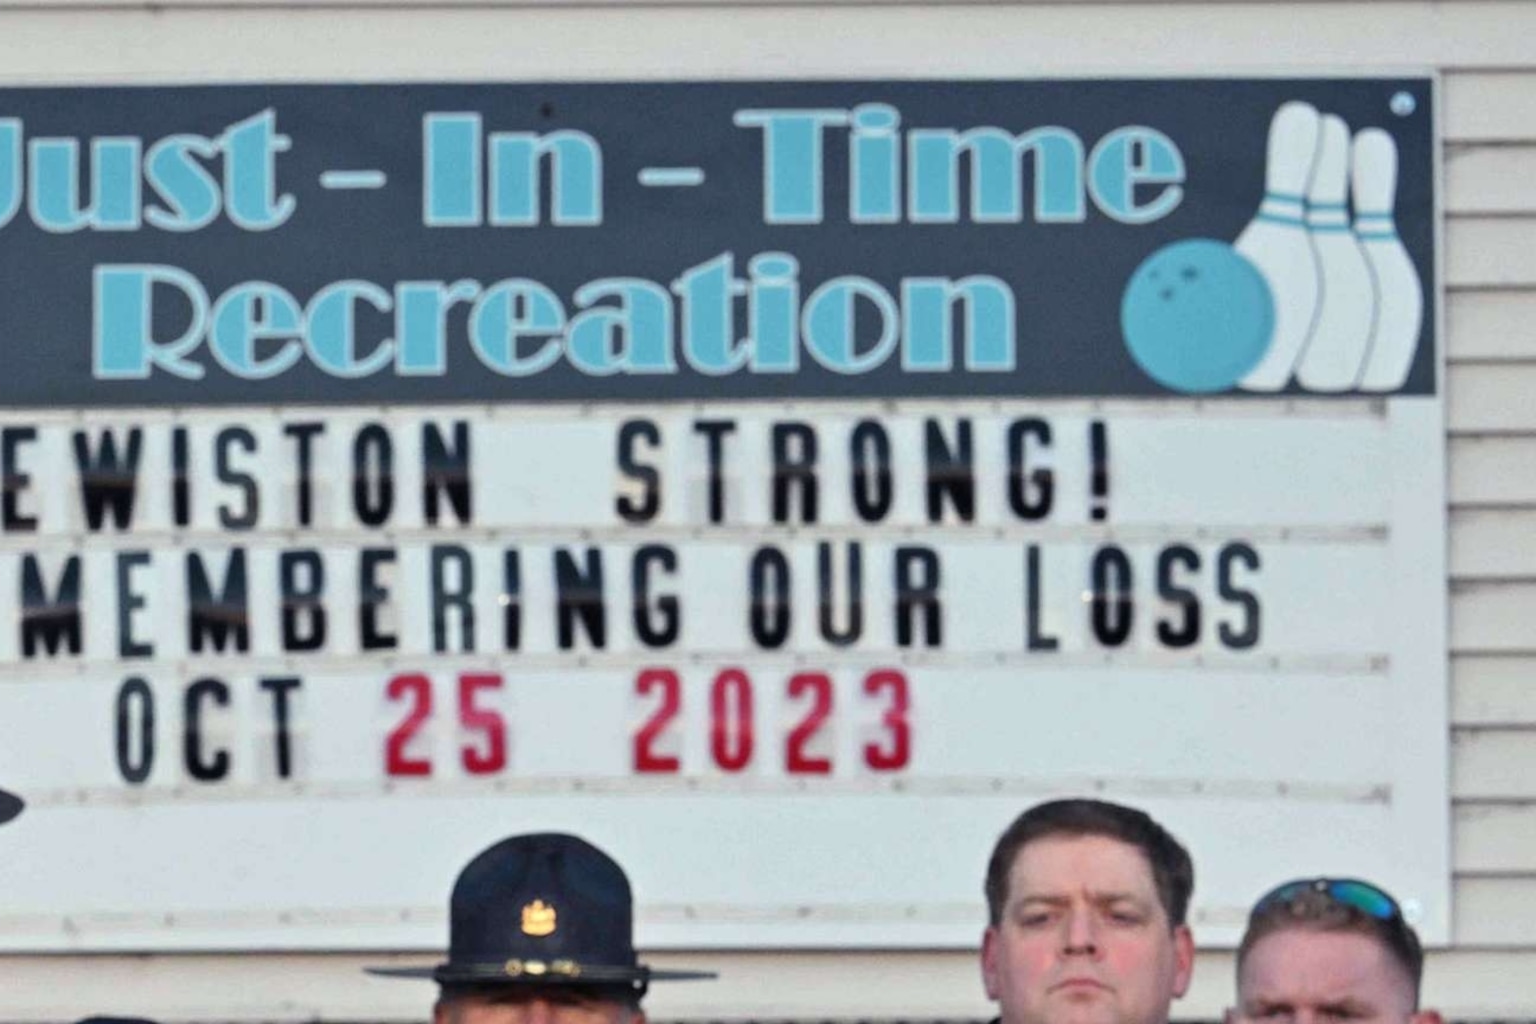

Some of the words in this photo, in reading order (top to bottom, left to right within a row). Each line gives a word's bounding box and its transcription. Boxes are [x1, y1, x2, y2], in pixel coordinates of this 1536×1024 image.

[91, 250, 1017, 381] Recreation
[615, 417, 1110, 525] STRONG!
[749, 541, 943, 651] OUR
[1027, 541, 1261, 652] LOSS
[115, 676, 302, 784] OCT
[384, 672, 508, 777] 25
[633, 667, 911, 775] 2023
